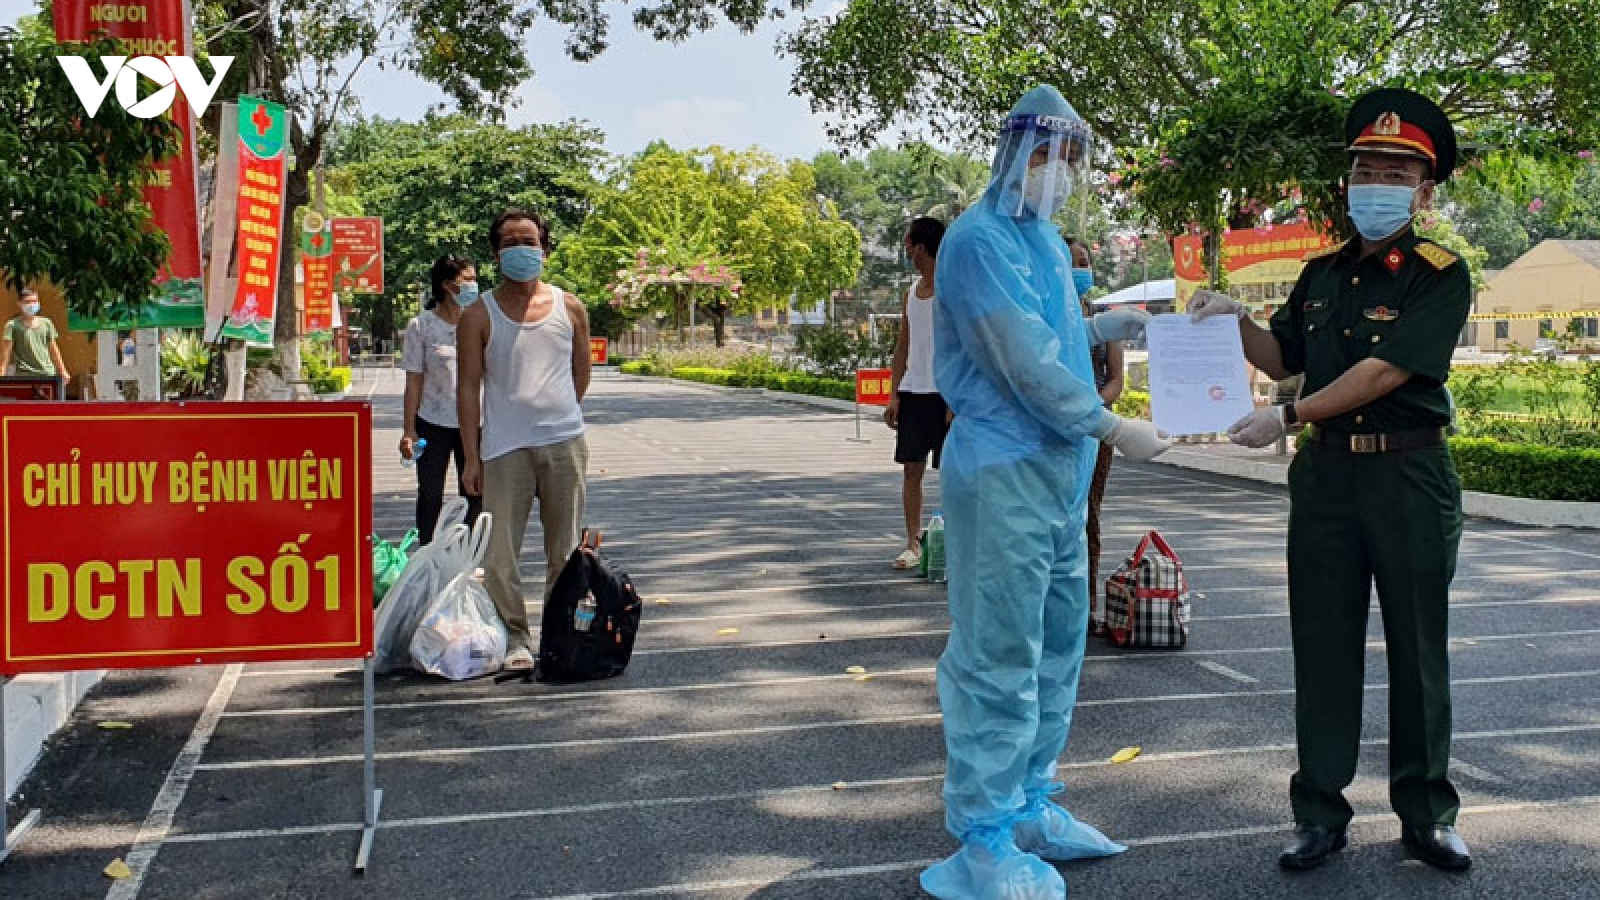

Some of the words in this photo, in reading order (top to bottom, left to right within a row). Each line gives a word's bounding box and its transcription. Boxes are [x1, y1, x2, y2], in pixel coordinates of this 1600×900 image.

[23, 447, 81, 507] CHỈ
[92, 461, 158, 505] HUY
[169, 451, 257, 513] BỆNH
[267, 449, 343, 510] VIỆN
[27, 557, 203, 623] DCTN
